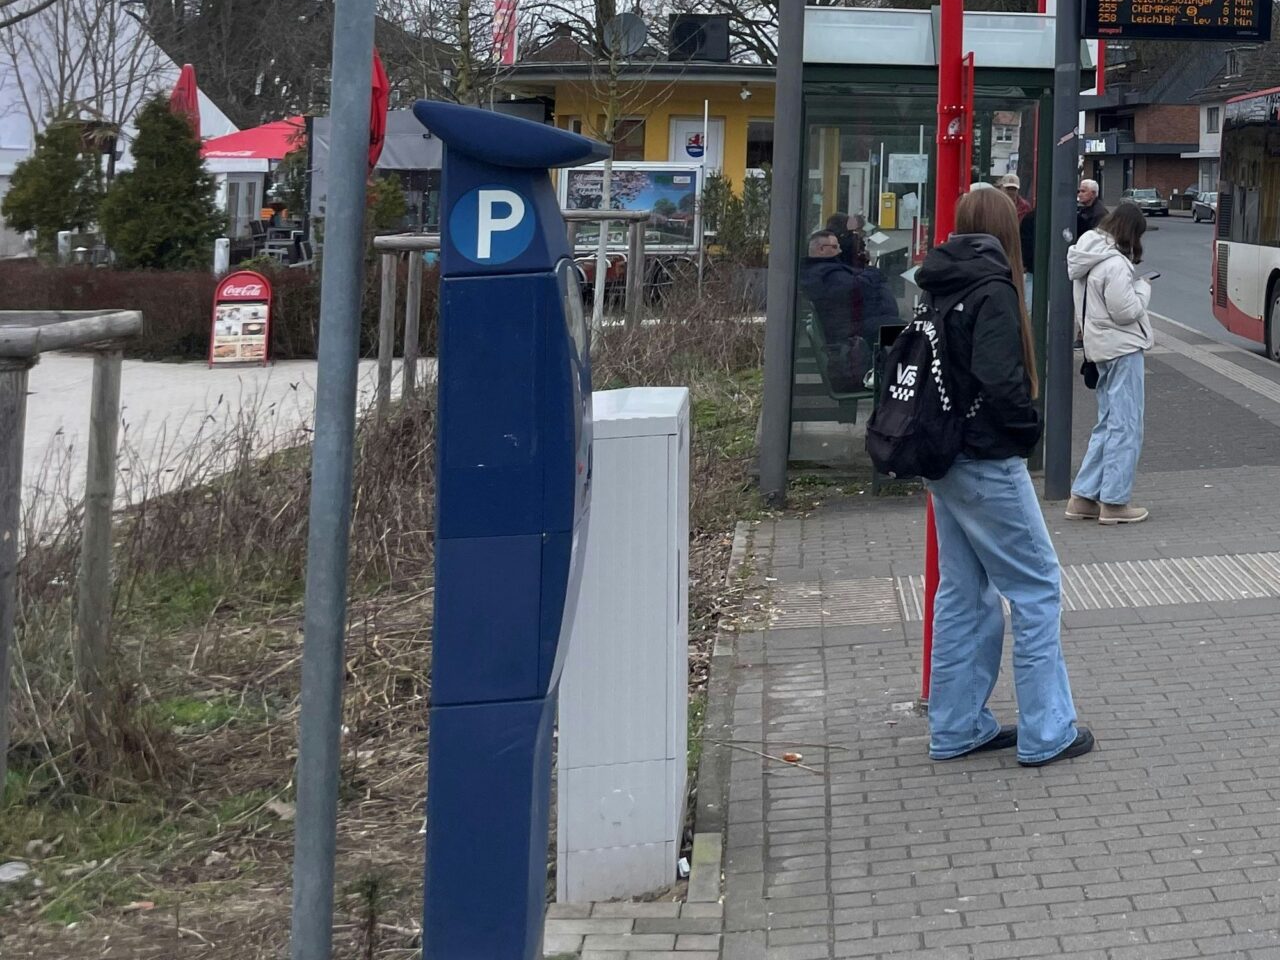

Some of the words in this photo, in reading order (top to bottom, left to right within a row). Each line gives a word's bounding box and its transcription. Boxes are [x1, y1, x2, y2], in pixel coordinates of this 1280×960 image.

[1098, 3, 1117, 12] 255
[1131, 4, 1182, 14] CHEMPARK
[1234, 7, 1253, 16] Min
[1098, 13, 1117, 22] 258
[1193, 16, 1211, 25] Lev
[1234, 17, 1252, 26] Min
[477, 190, 525, 258] P
